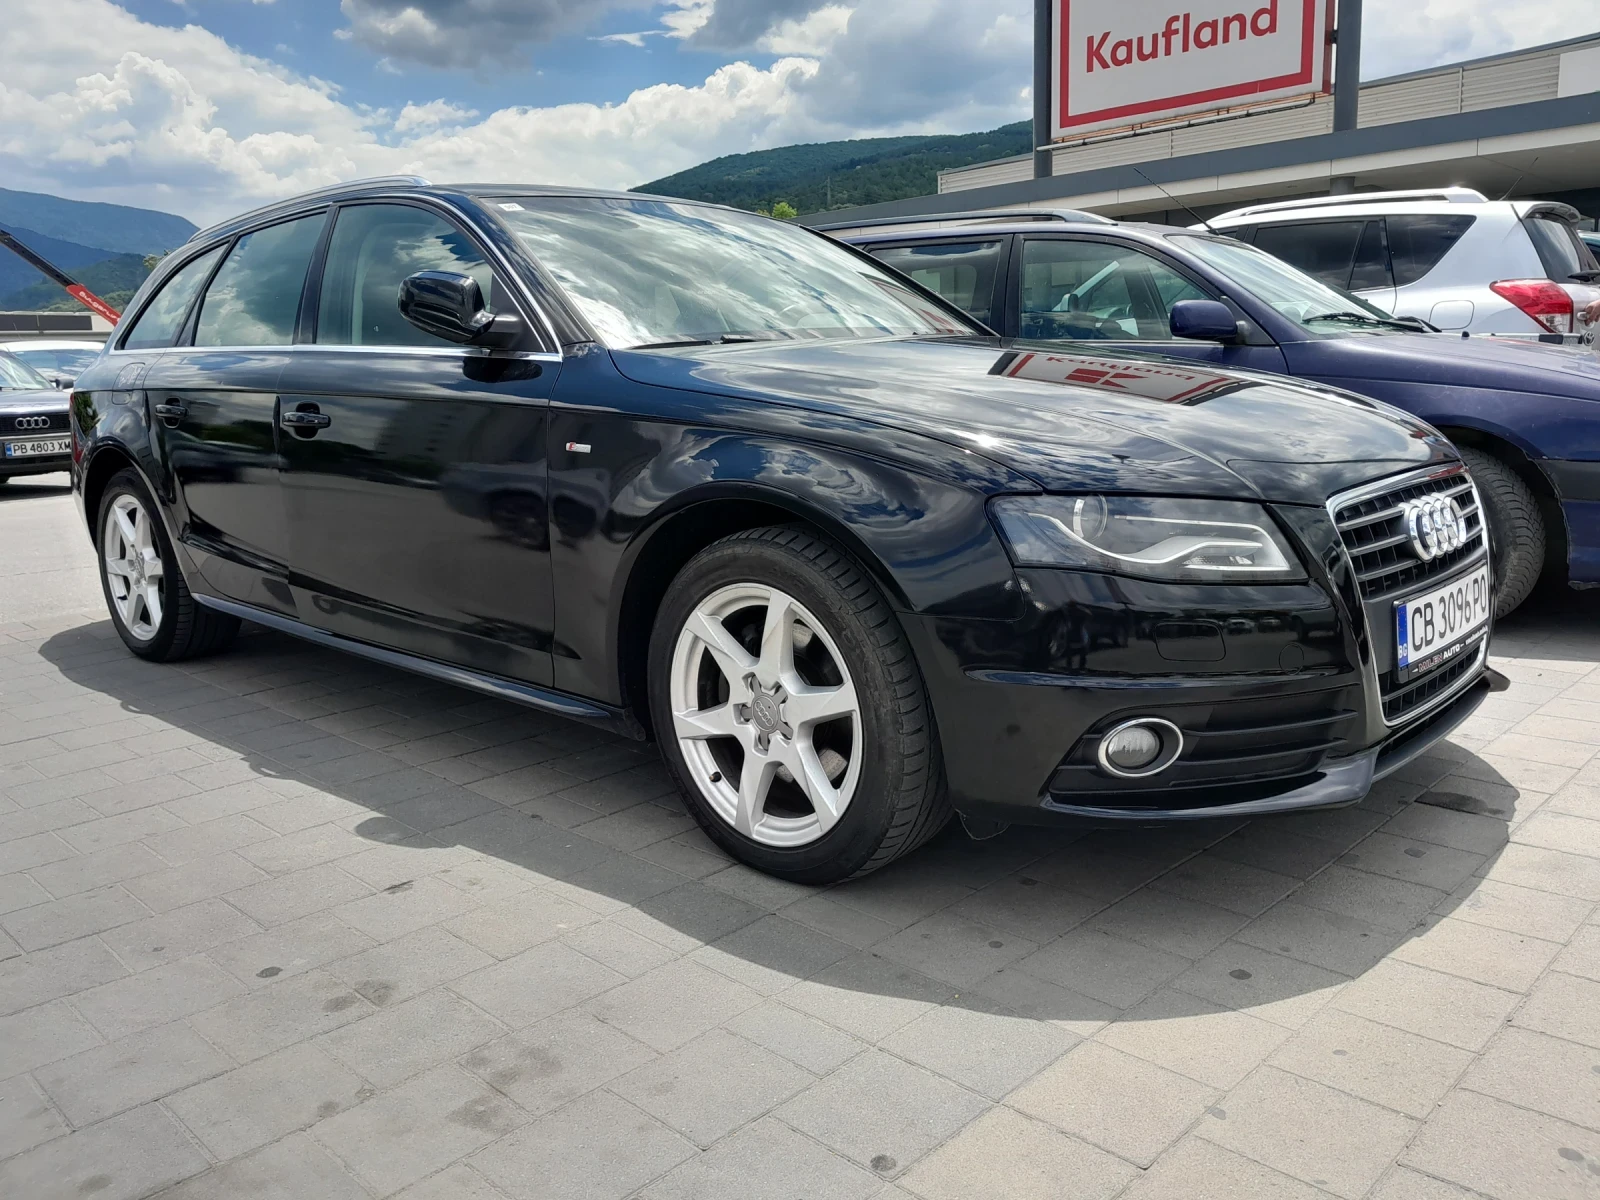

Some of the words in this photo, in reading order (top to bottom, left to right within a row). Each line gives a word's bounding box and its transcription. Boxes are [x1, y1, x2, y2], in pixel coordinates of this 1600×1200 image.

[1086, 0, 1278, 73] Kaufland
[13, 444, 28, 454] PB
[30, 442, 55, 453] 4803
[57, 441, 72, 451] XM
[1412, 602, 1435, 651] CB
[1438, 583, 1471, 639] 3096
[1473, 574, 1487, 619] PO
[1399, 643, 1408, 659] BG
[1418, 653, 1443, 672] MILEN
[1442, 643, 1460, 659] AUTO
